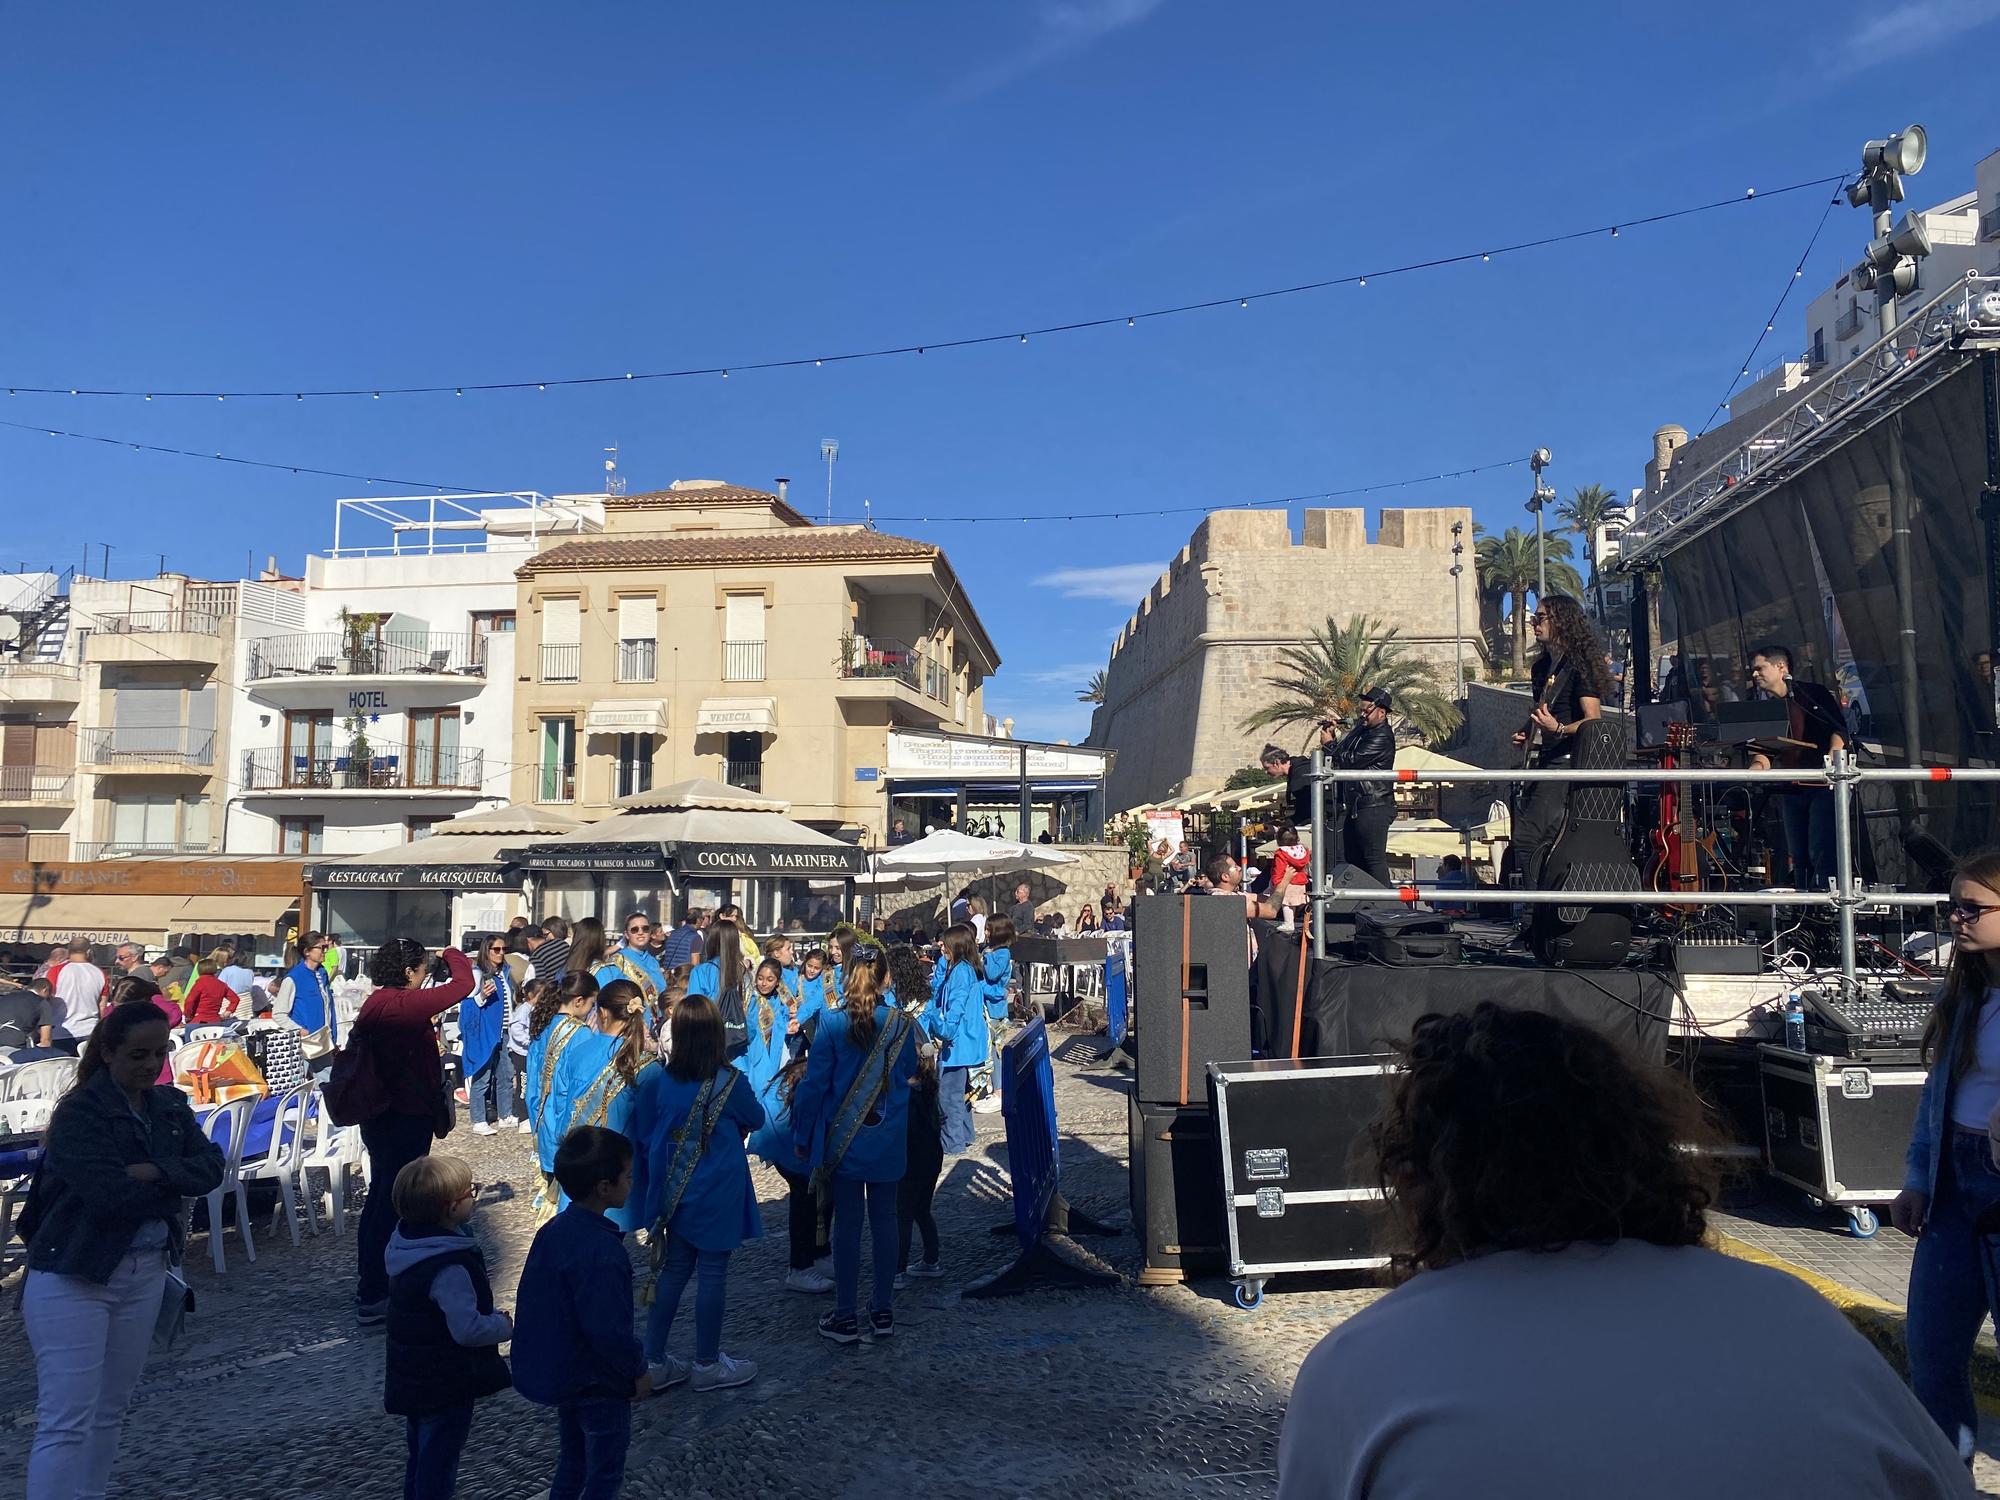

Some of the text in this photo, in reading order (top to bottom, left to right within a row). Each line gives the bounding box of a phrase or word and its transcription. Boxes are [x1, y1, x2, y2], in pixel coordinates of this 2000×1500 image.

[349, 691, 388, 708] HOTEL
[594, 713, 649, 724] RESTAURANTE
[710, 712, 752, 722] VENECIA
[557, 859, 586, 868] PESCADOS
[594, 860, 624, 868] MARISCOS
[626, 860, 655, 868] SALVAJES
[770, 854, 849, 868] MARINERA
[328, 871, 504, 885] RESTAURANT MARISQUERIA
[41, 932, 49, 940] Y
